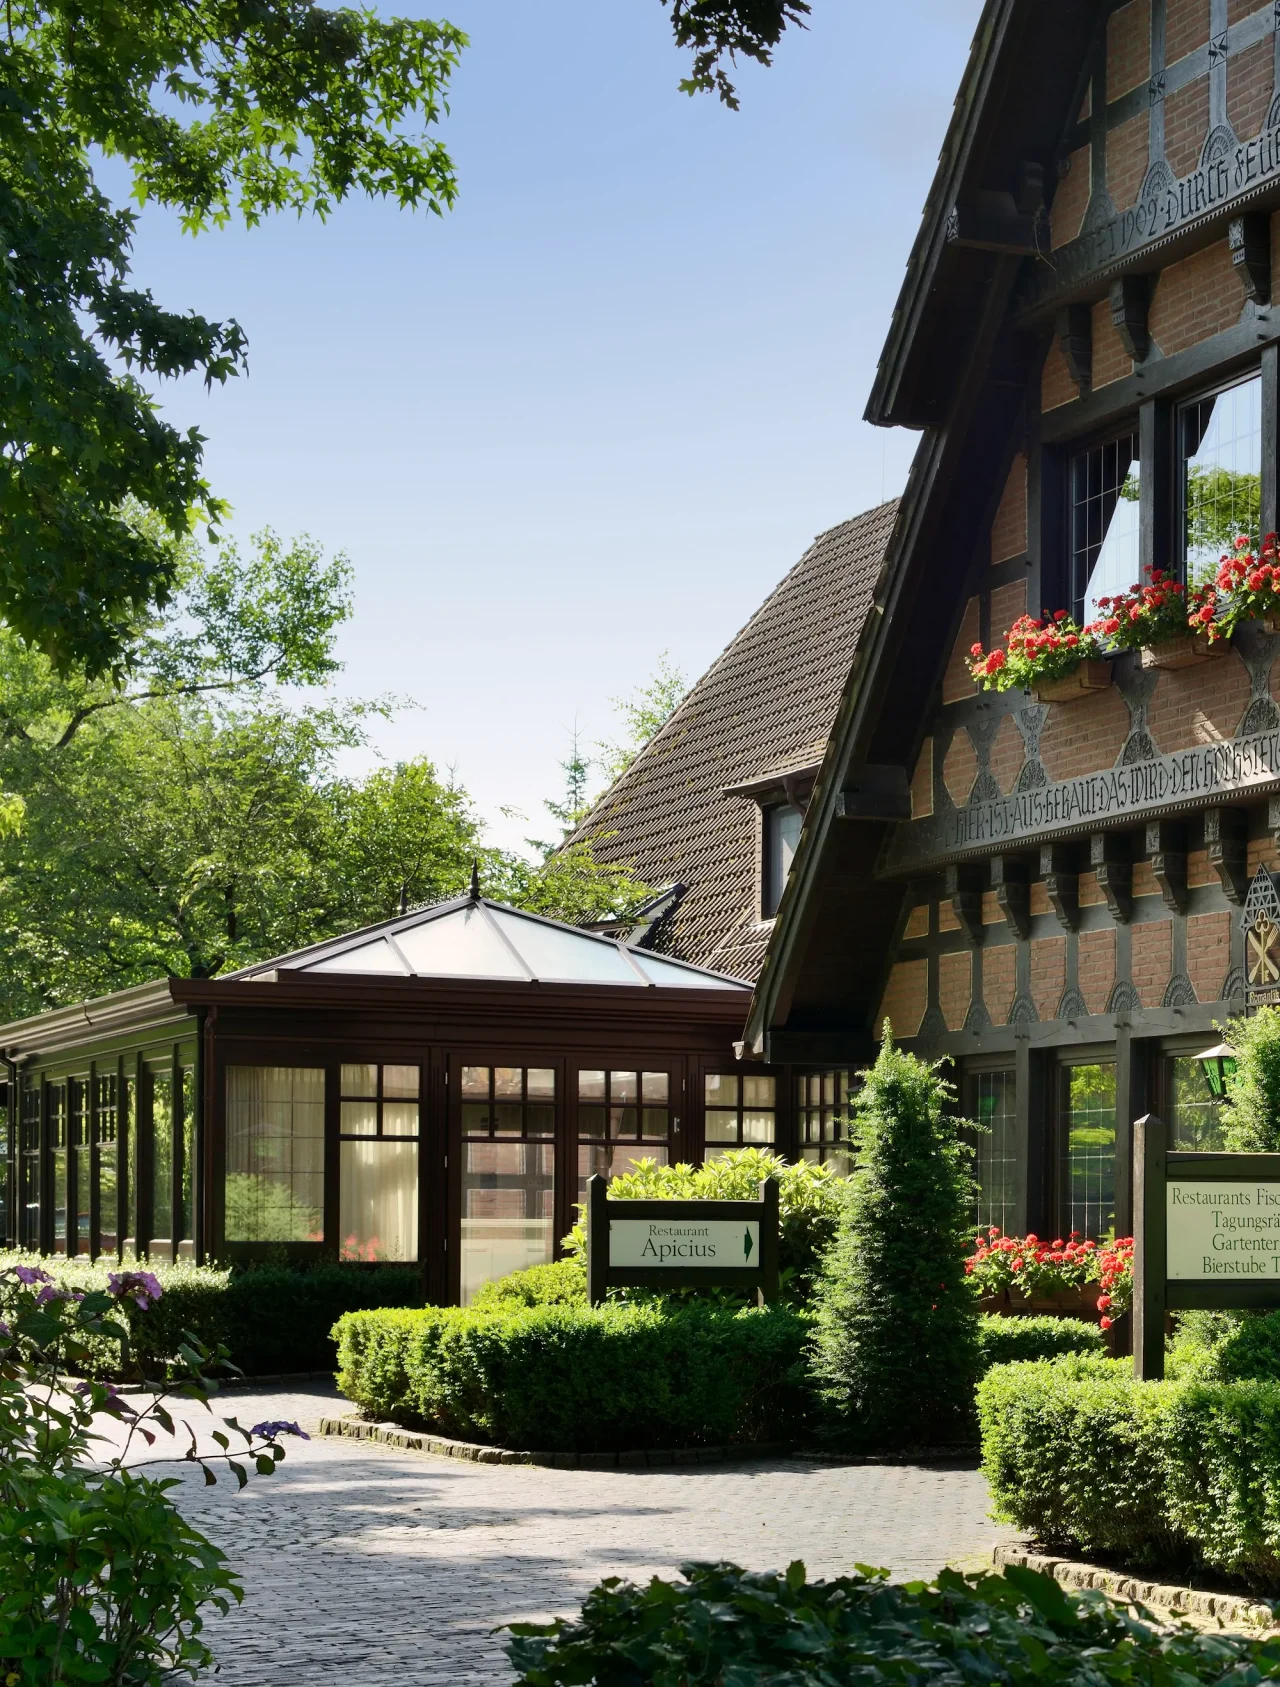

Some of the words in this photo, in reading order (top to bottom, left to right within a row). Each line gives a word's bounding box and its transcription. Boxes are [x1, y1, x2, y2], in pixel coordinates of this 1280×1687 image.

[1164, 159, 1229, 229] DURCH
[989, 800, 1011, 837] IST
[1099, 771, 1127, 812] DAS
[1131, 762, 1169, 806] WIRD
[1170, 752, 1200, 797] DEN
[1172, 1187, 1251, 1205] Restaurants
[649, 1224, 709, 1236] Restaurant
[640, 1237, 716, 1262] Apicius
[1202, 1255, 1266, 1274] Bierstube
